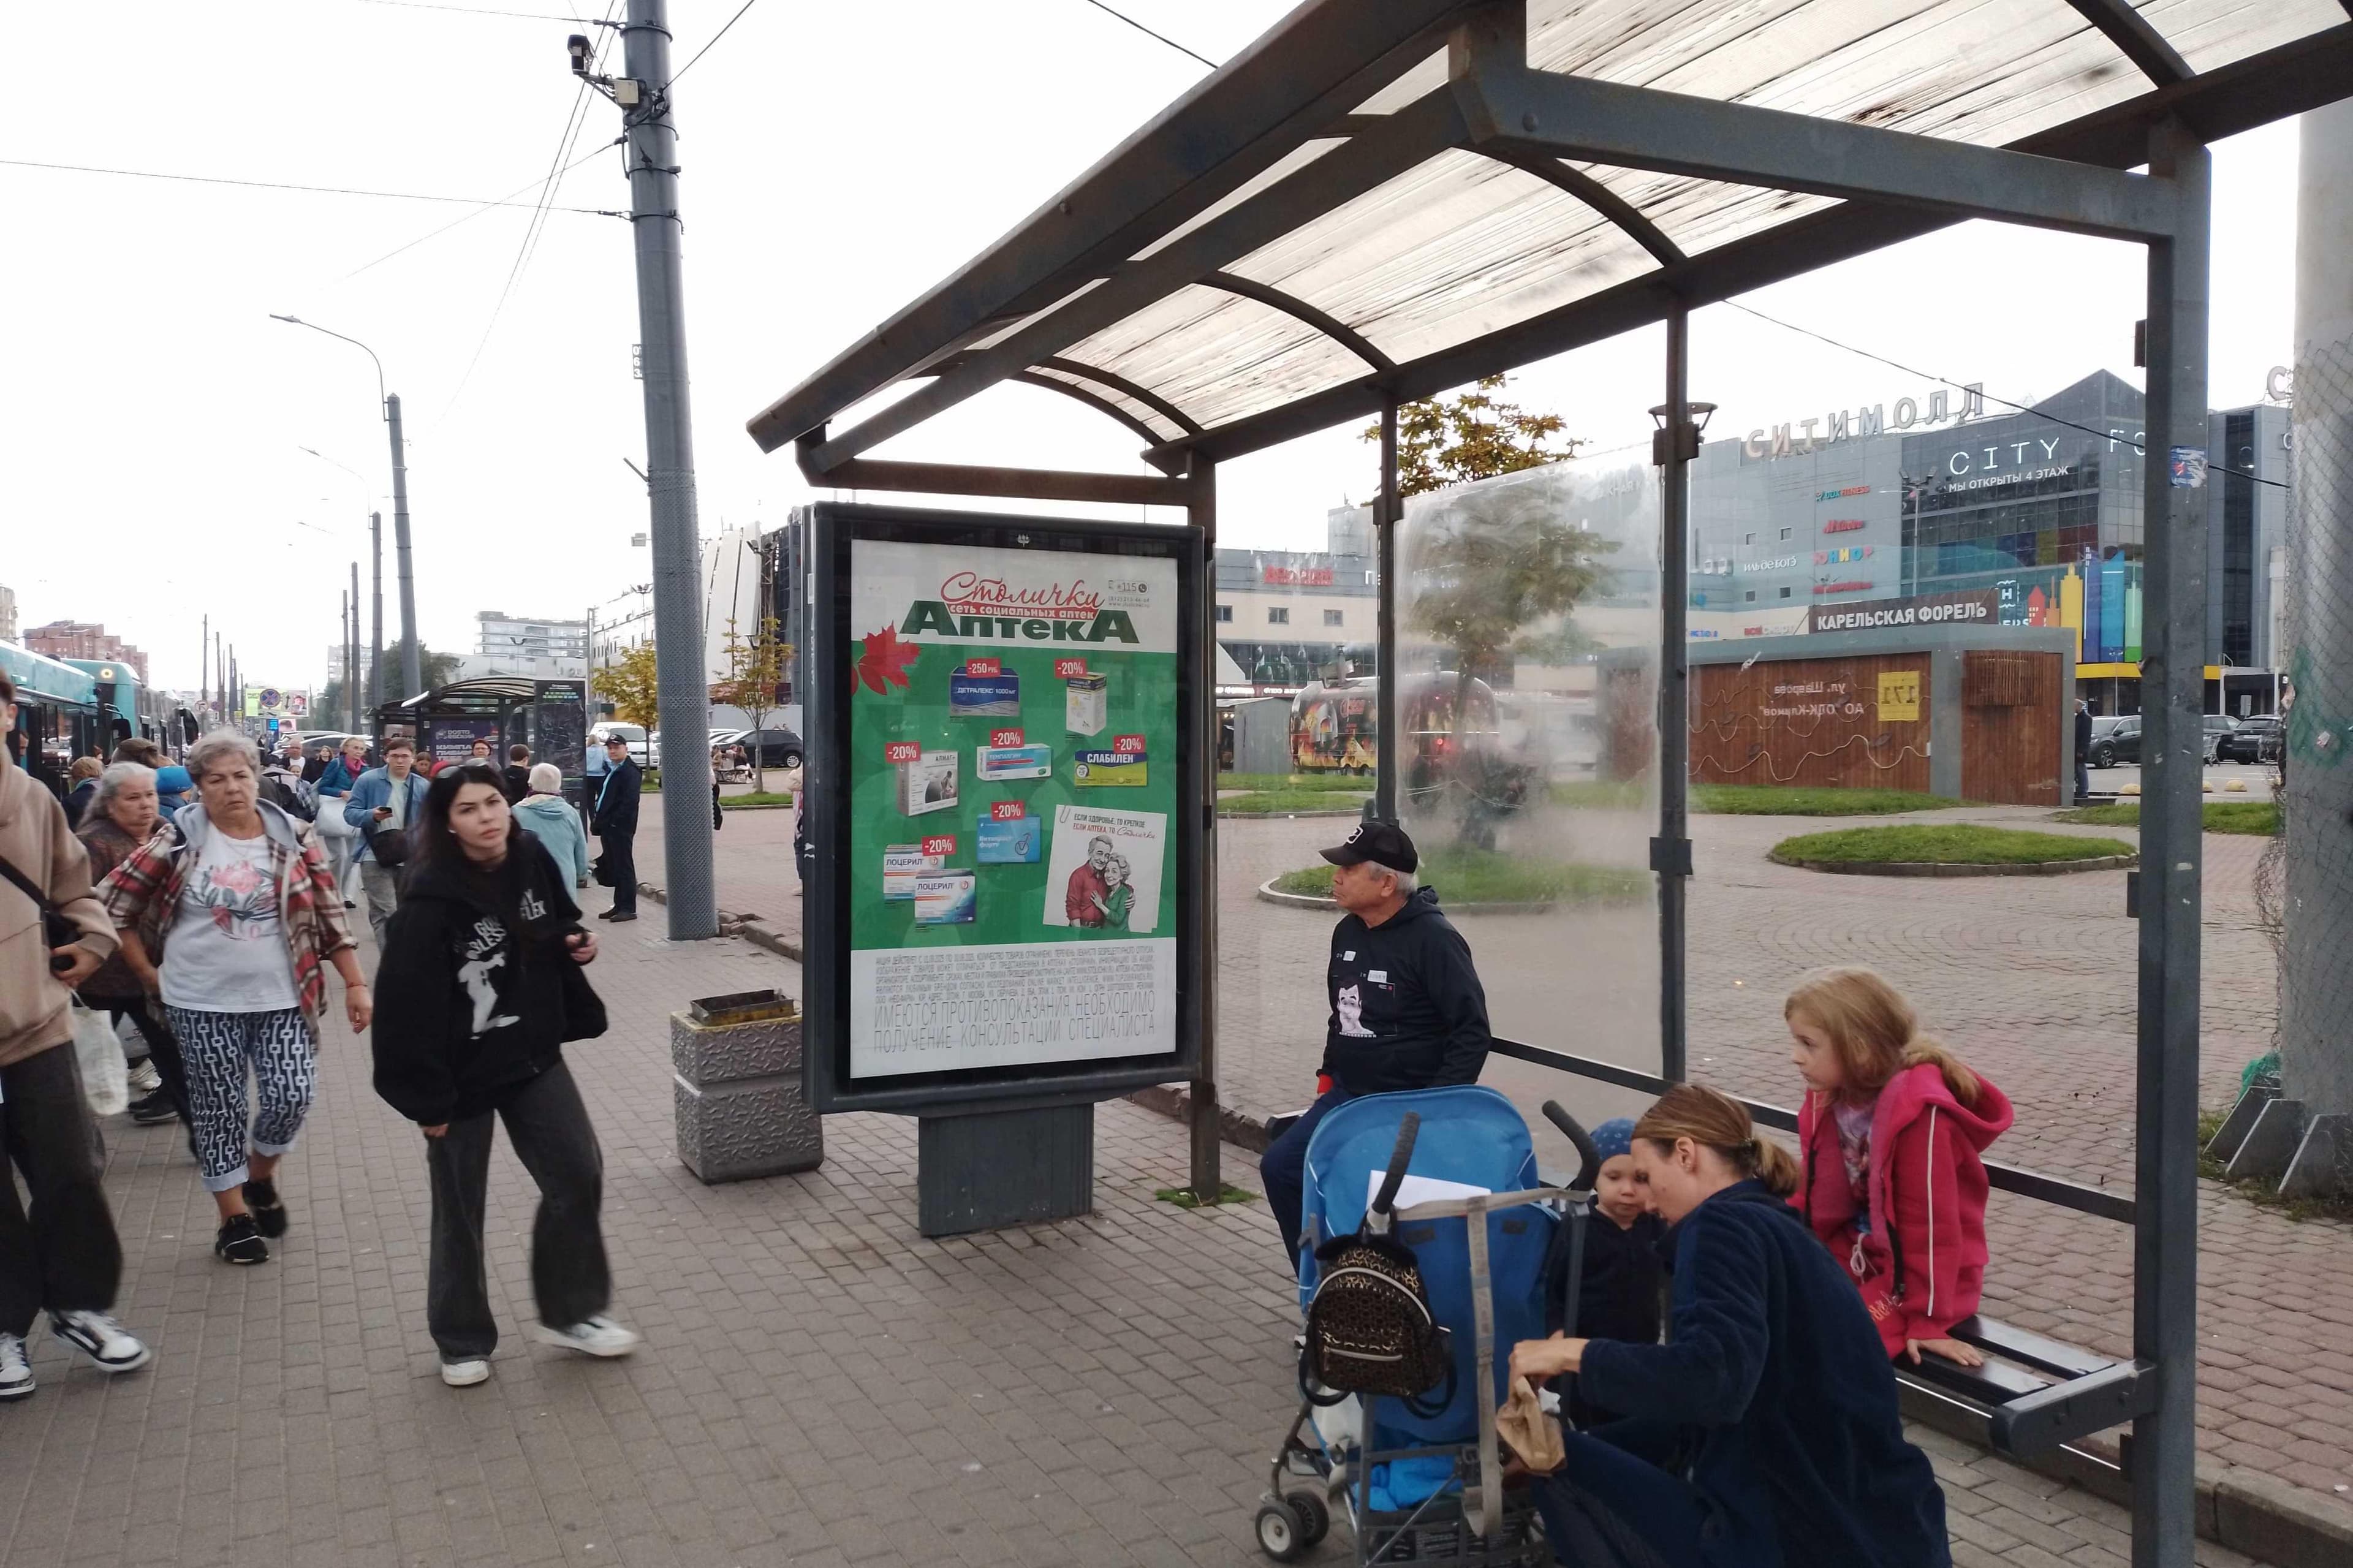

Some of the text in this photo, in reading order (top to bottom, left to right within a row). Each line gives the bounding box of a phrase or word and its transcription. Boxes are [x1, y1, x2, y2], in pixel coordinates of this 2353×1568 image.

[1746, 383, 1984, 458] СИТИМОЛЛ
[1950, 437, 2059, 475] CITY
[1949, 465, 2069, 492] МЫ ОТКРЫТЫ 4 ЭТАЖ
[941, 572, 1105, 608] Столички
[950, 604, 1094, 619] сеть социальных аптек
[1817, 602, 1987, 631] КАРЕЛЬСКАЯ ФОРЕЛЬ
[968, 663, 987, 673] -250
[1058, 662, 1083, 675] -20%
[993, 732, 1020, 745] -20%
[1116, 738, 1141, 751] -20%
[888, 745, 917, 759] -20%
[1087, 754, 1134, 763] СЛАБИЛЕН
[993, 804, 1021, 818] -20%
[925, 839, 952, 853] -20%
[917, 882, 953, 891] ЛОЦЕРИЛ
[874, 1001, 937, 1028] ИМЕЮТСЯ
[1075, 990, 1155, 1016] НЕОБХОДИМО
[874, 1013, 1155, 1053] ПОЛУЧЕНИЕ КОНСУЛЬТАЦИИ СПЕЦИАЛИСТА
